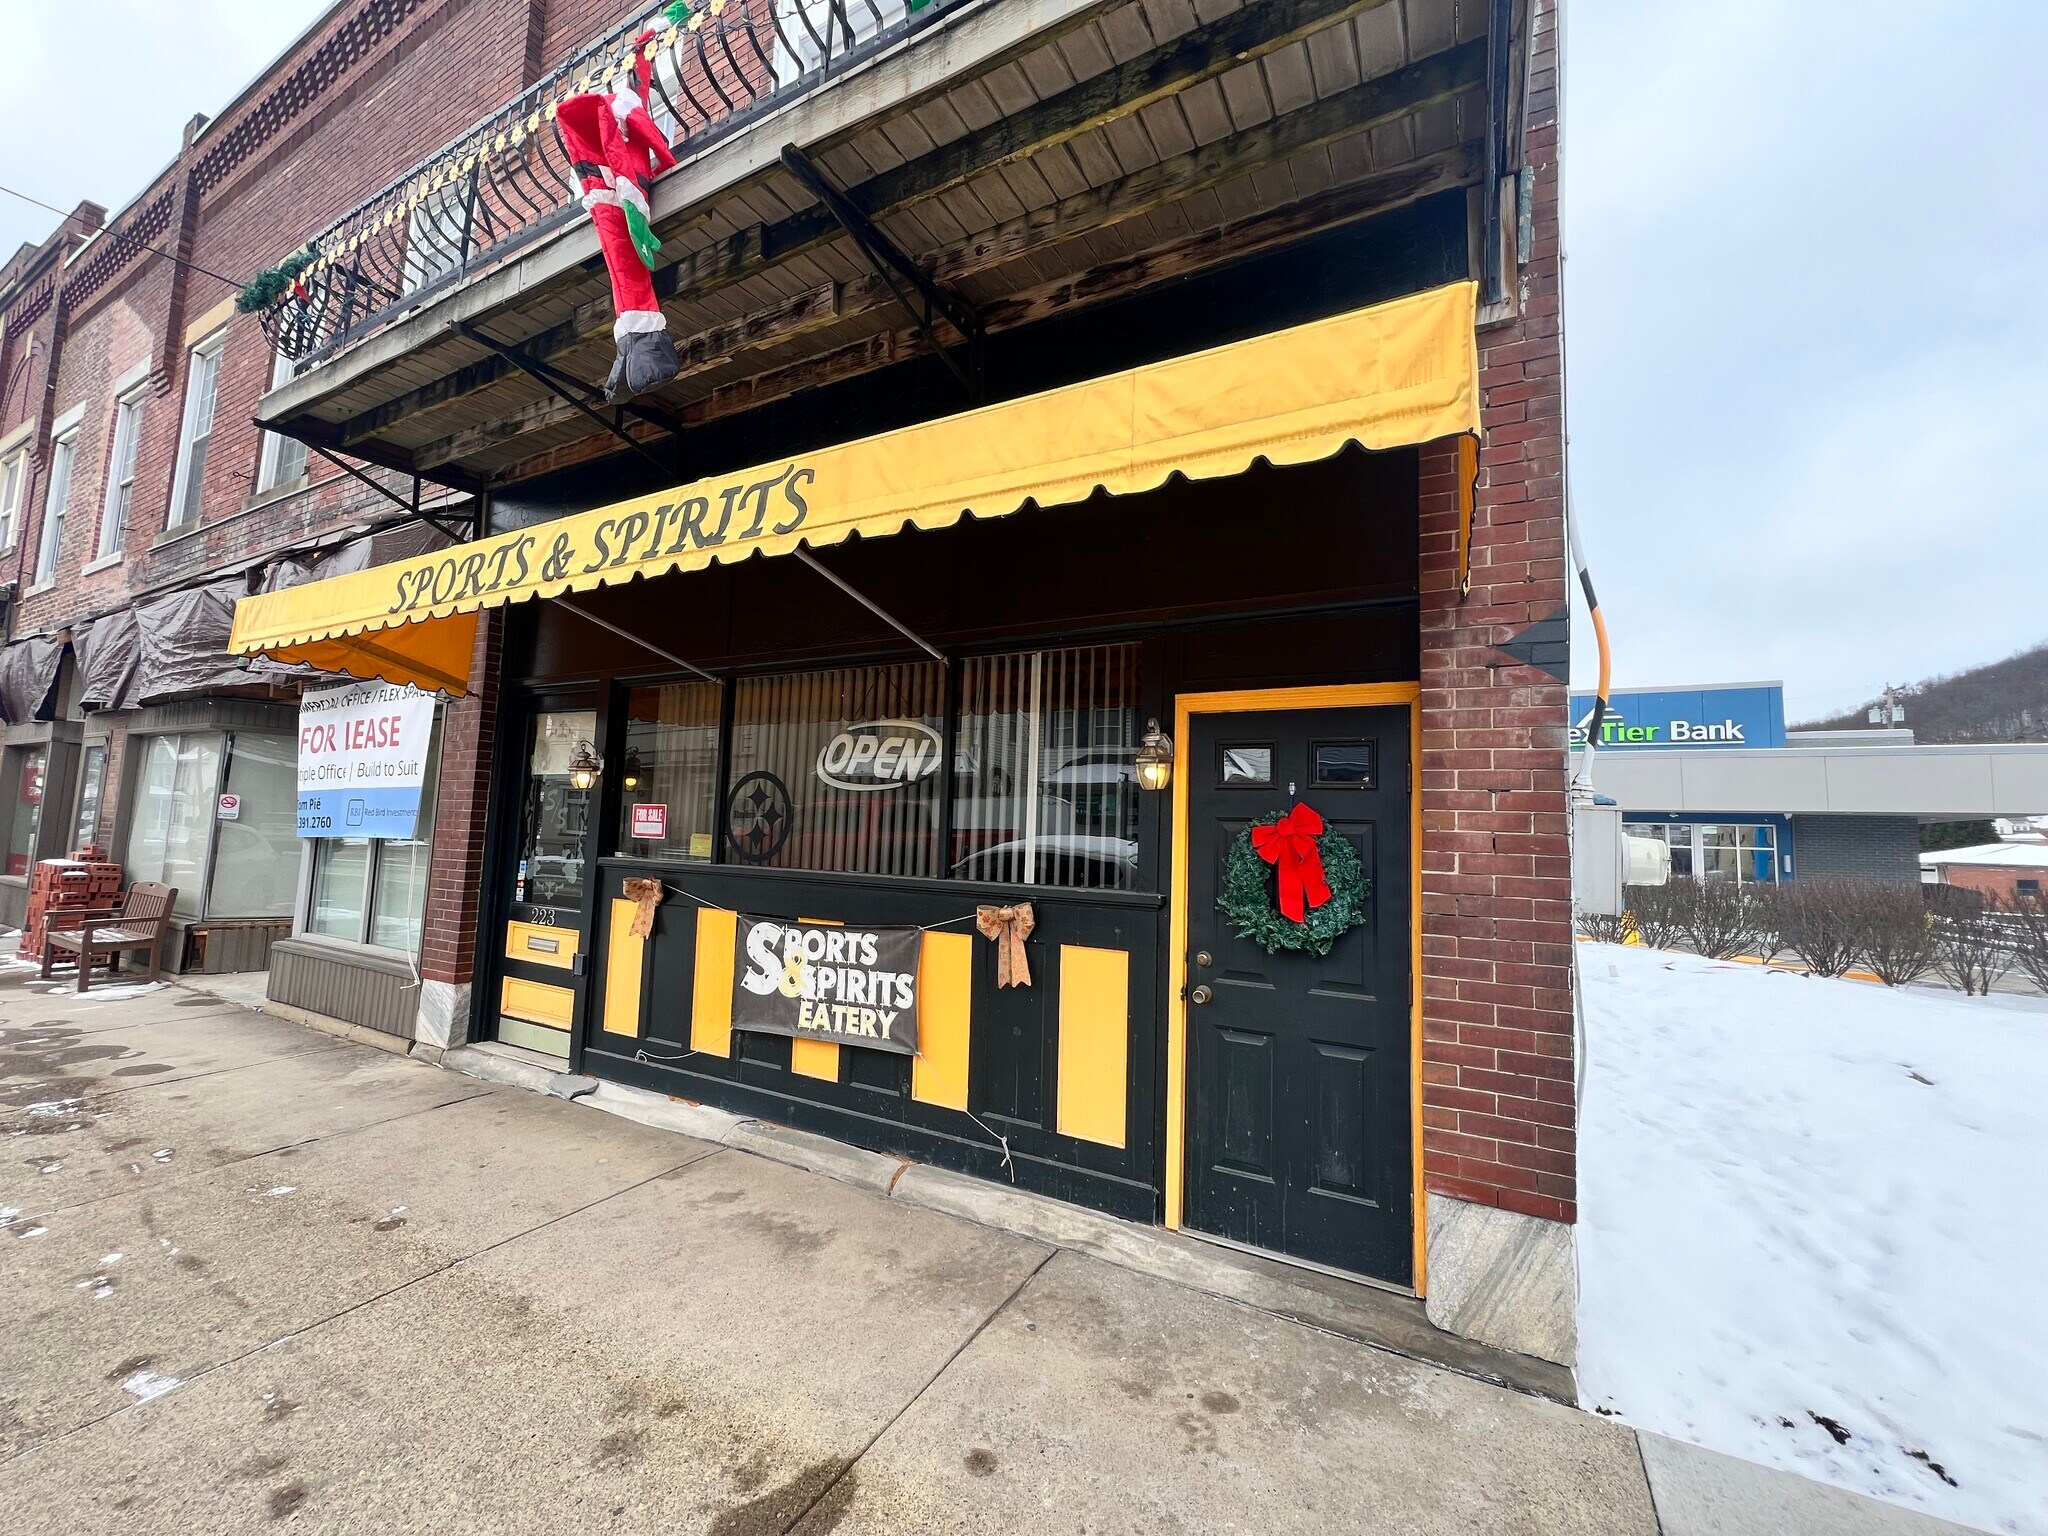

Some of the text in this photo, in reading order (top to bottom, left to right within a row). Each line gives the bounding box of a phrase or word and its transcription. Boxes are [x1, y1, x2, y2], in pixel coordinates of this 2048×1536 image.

[388, 463, 815, 614] SPORTS & SPIRITS
[299, 696, 339, 714] MERCIAL
[341, 691, 371, 708] OFFICE
[379, 687, 401, 703] FLEX
[300, 715, 402, 755] FOR LEASE
[1670, 719, 1745, 741] Bank
[825, 733, 930, 782] OPEN
[317, 763, 347, 780] Office
[357, 761, 382, 778] Build
[384, 762, 395, 777] to
[397, 760, 419, 776] Suit
[309, 797, 321, 810] Pié
[364, 808, 375, 816] Red
[635, 808, 663, 822] FOR SALE
[531, 907, 556, 926] 223
[741, 922, 878, 995] SPORTS
[798, 998, 899, 1039] EATERY
